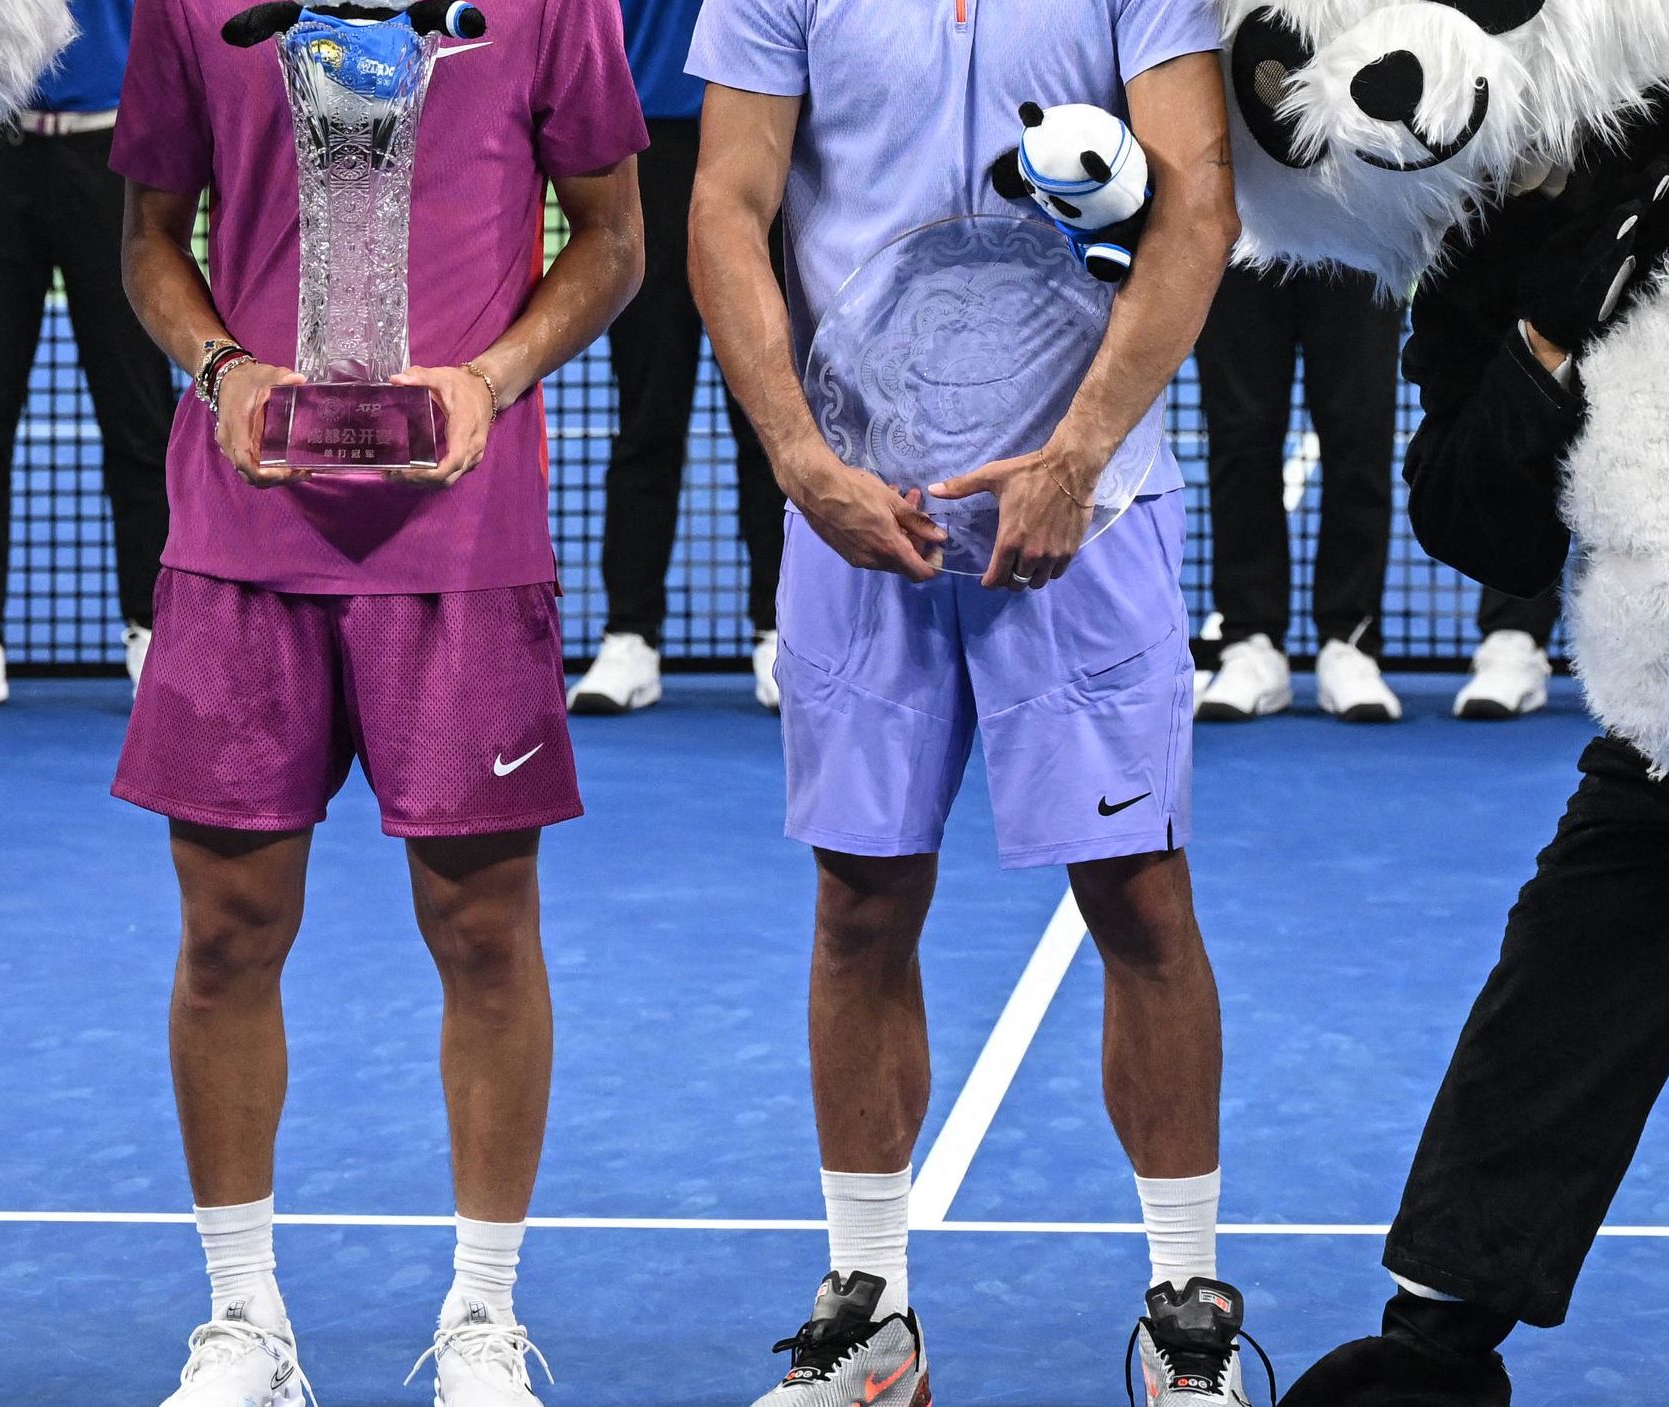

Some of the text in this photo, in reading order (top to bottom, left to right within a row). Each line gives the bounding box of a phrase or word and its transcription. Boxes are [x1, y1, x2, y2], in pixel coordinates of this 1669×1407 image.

[355, 403, 382, 413] ATP
[307, 428, 394, 445] 成都公开赛
